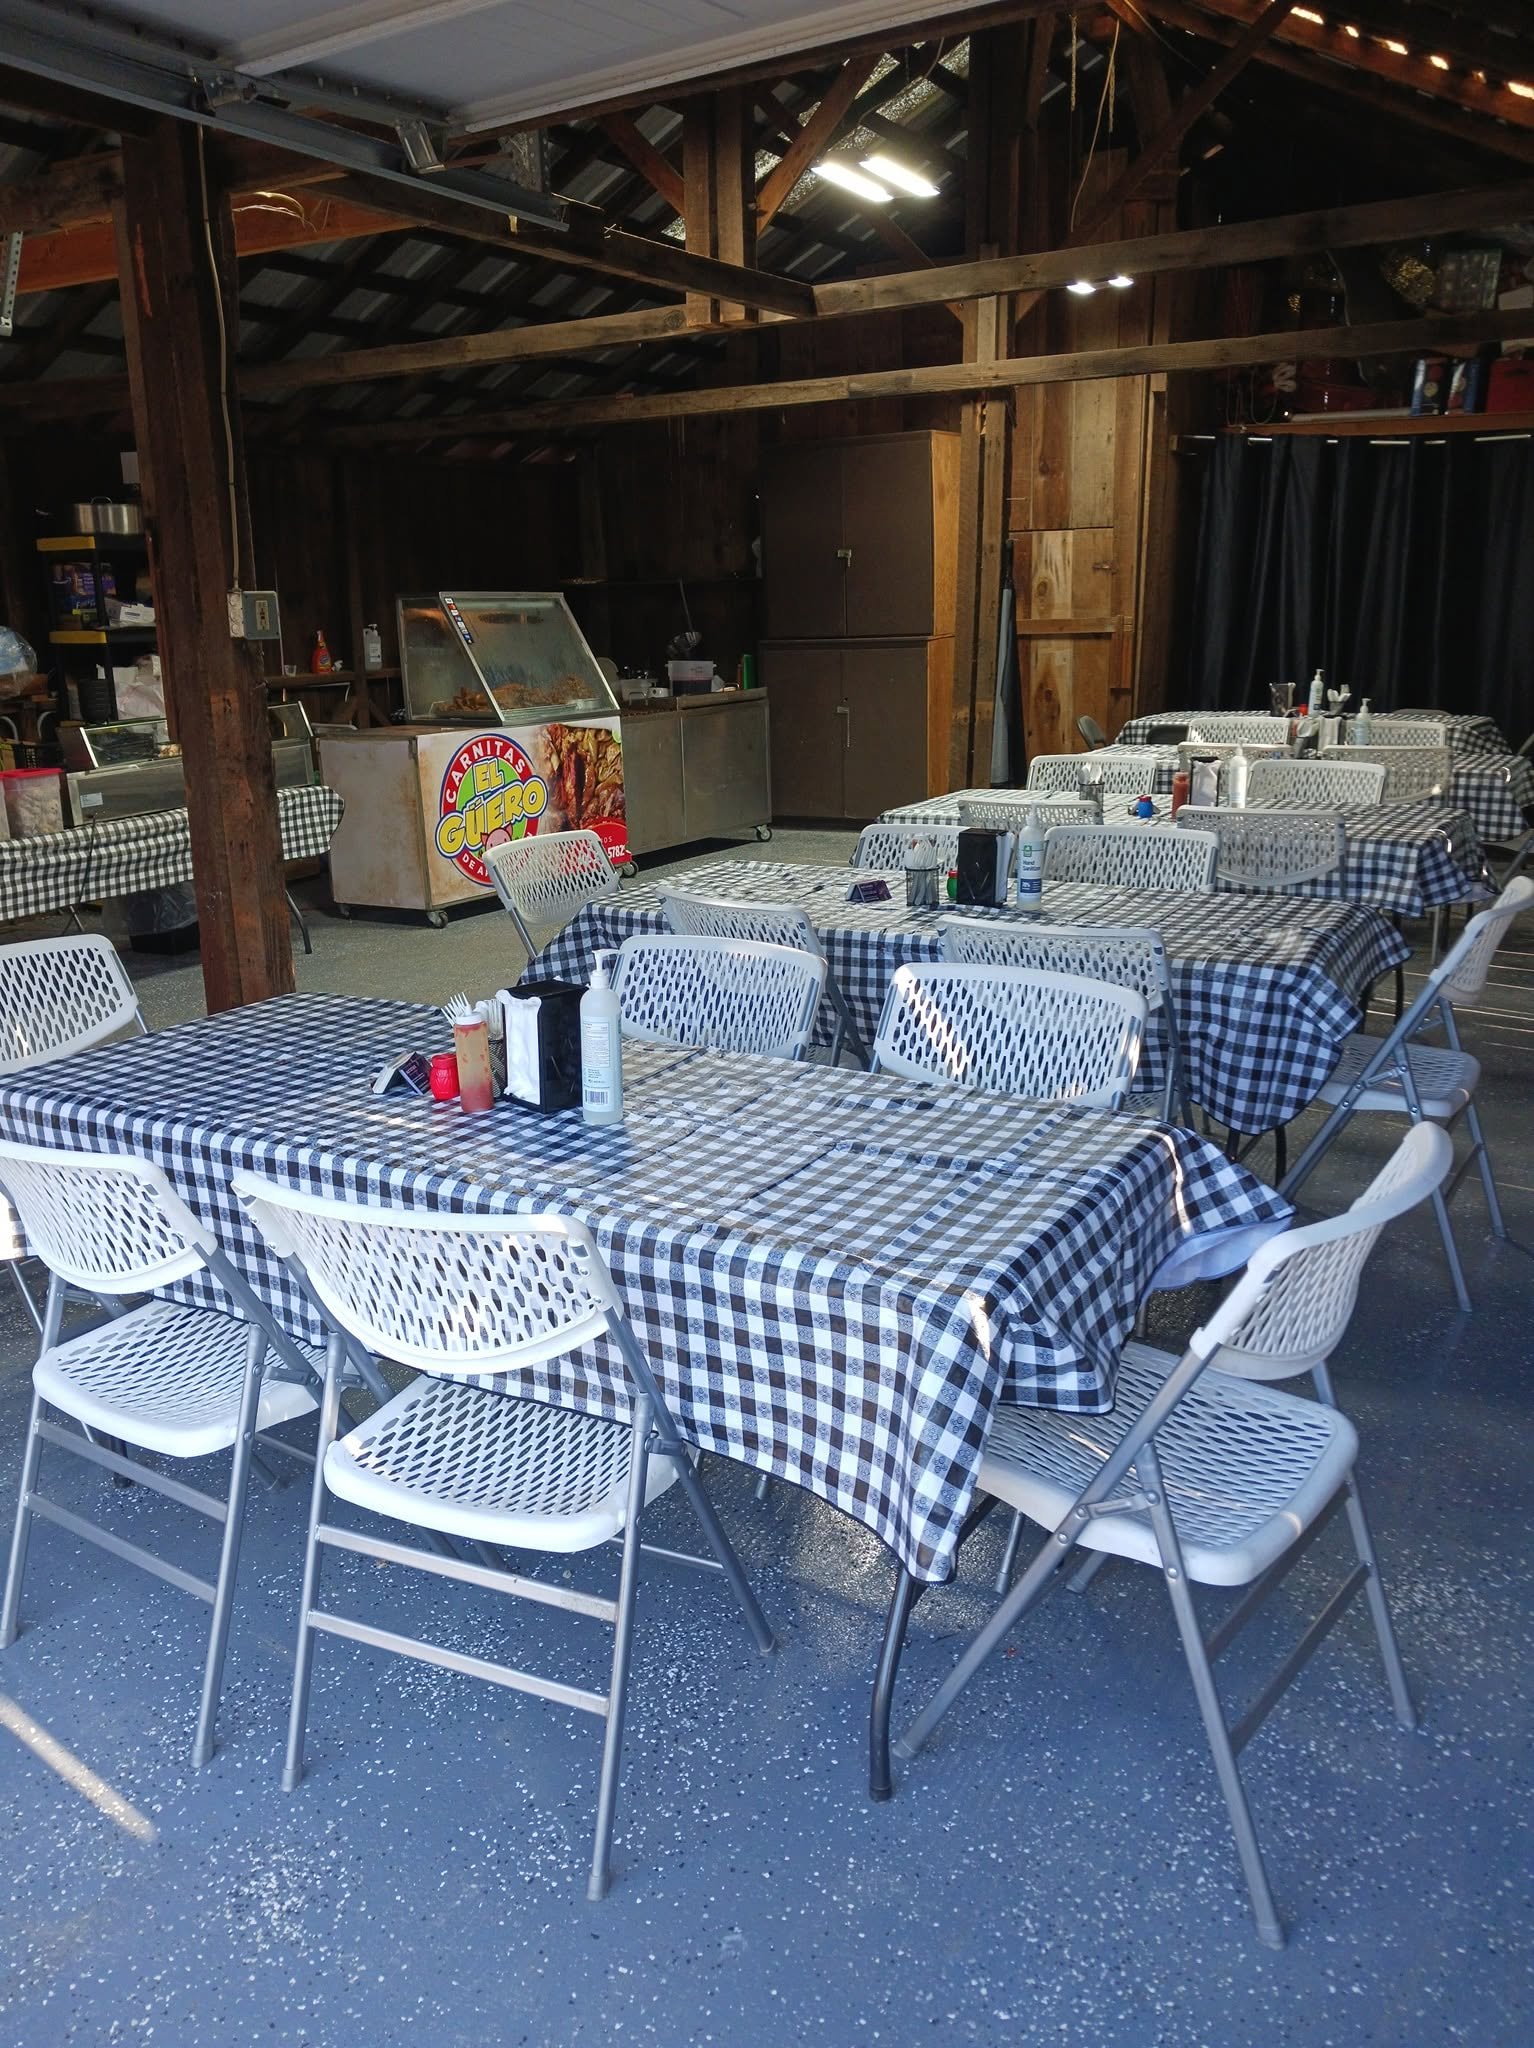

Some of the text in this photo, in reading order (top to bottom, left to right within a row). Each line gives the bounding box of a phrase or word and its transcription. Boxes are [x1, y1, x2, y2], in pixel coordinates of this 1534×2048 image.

[446, 740, 526, 804] CARNITAS
[474, 760, 504, 794] EL
[438, 780, 545, 854] GÜERO
[462, 853, 476, 871] DE
